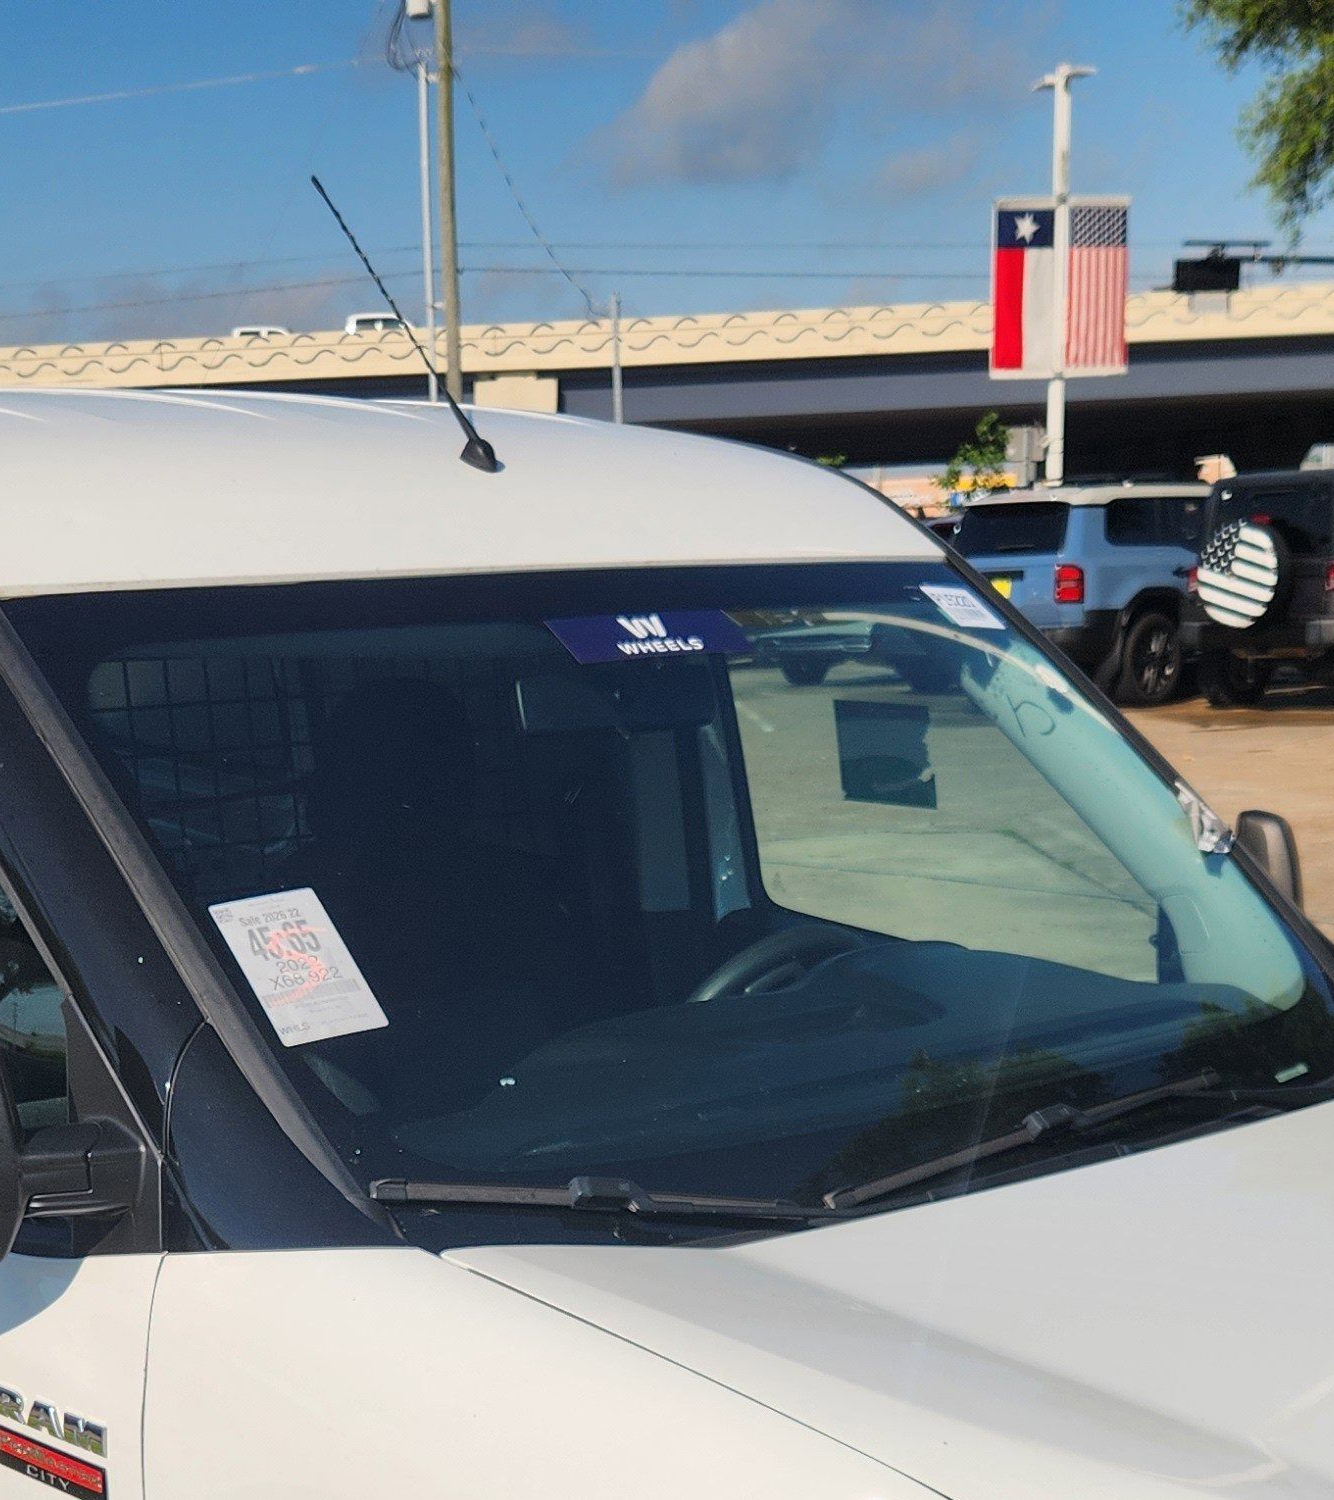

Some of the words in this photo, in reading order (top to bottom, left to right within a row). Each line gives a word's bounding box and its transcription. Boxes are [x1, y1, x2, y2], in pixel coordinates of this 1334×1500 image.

[616, 636, 704, 655] WHEELS
[238, 916, 262, 927] Sale
[26, 1464, 70, 1490] CITY
